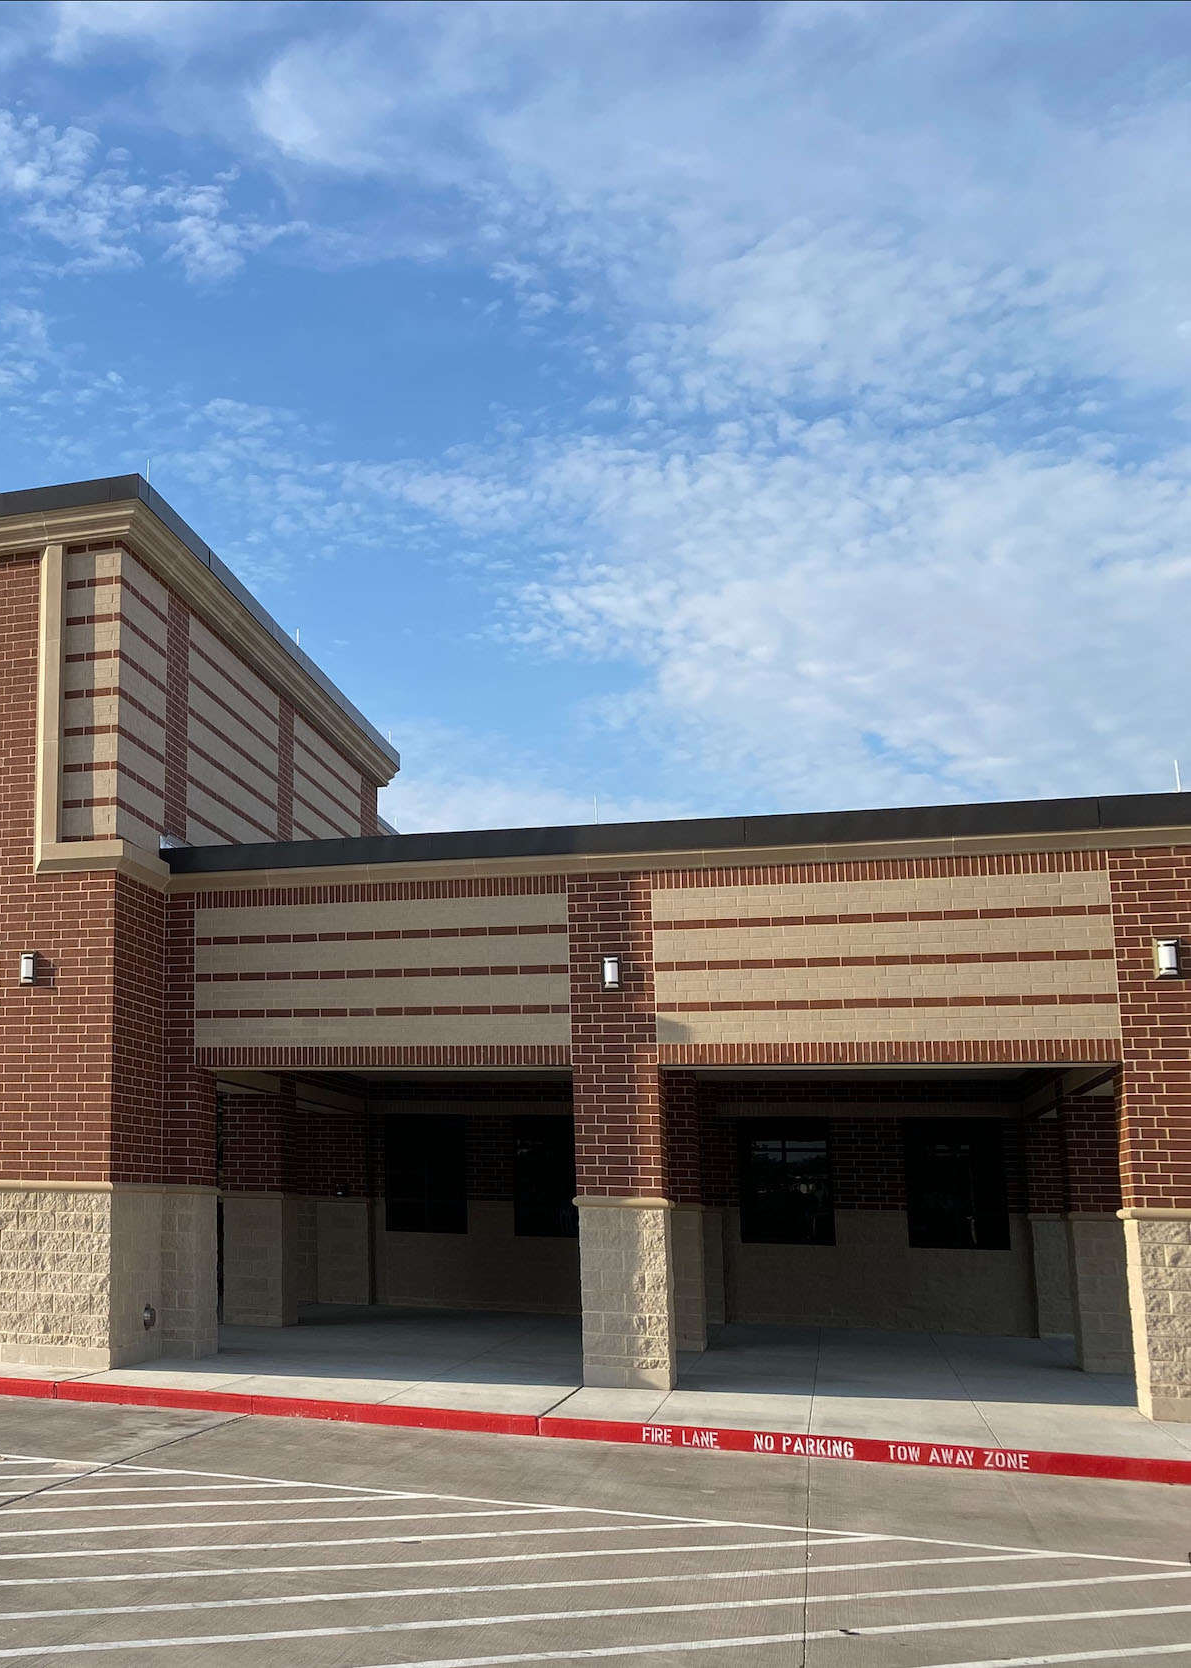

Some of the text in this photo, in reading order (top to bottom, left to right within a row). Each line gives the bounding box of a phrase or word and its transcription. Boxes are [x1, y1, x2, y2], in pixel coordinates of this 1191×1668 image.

[641, 1426, 1030, 1470] FIRE LANE NO PARKING TOW AWAY ZONE
